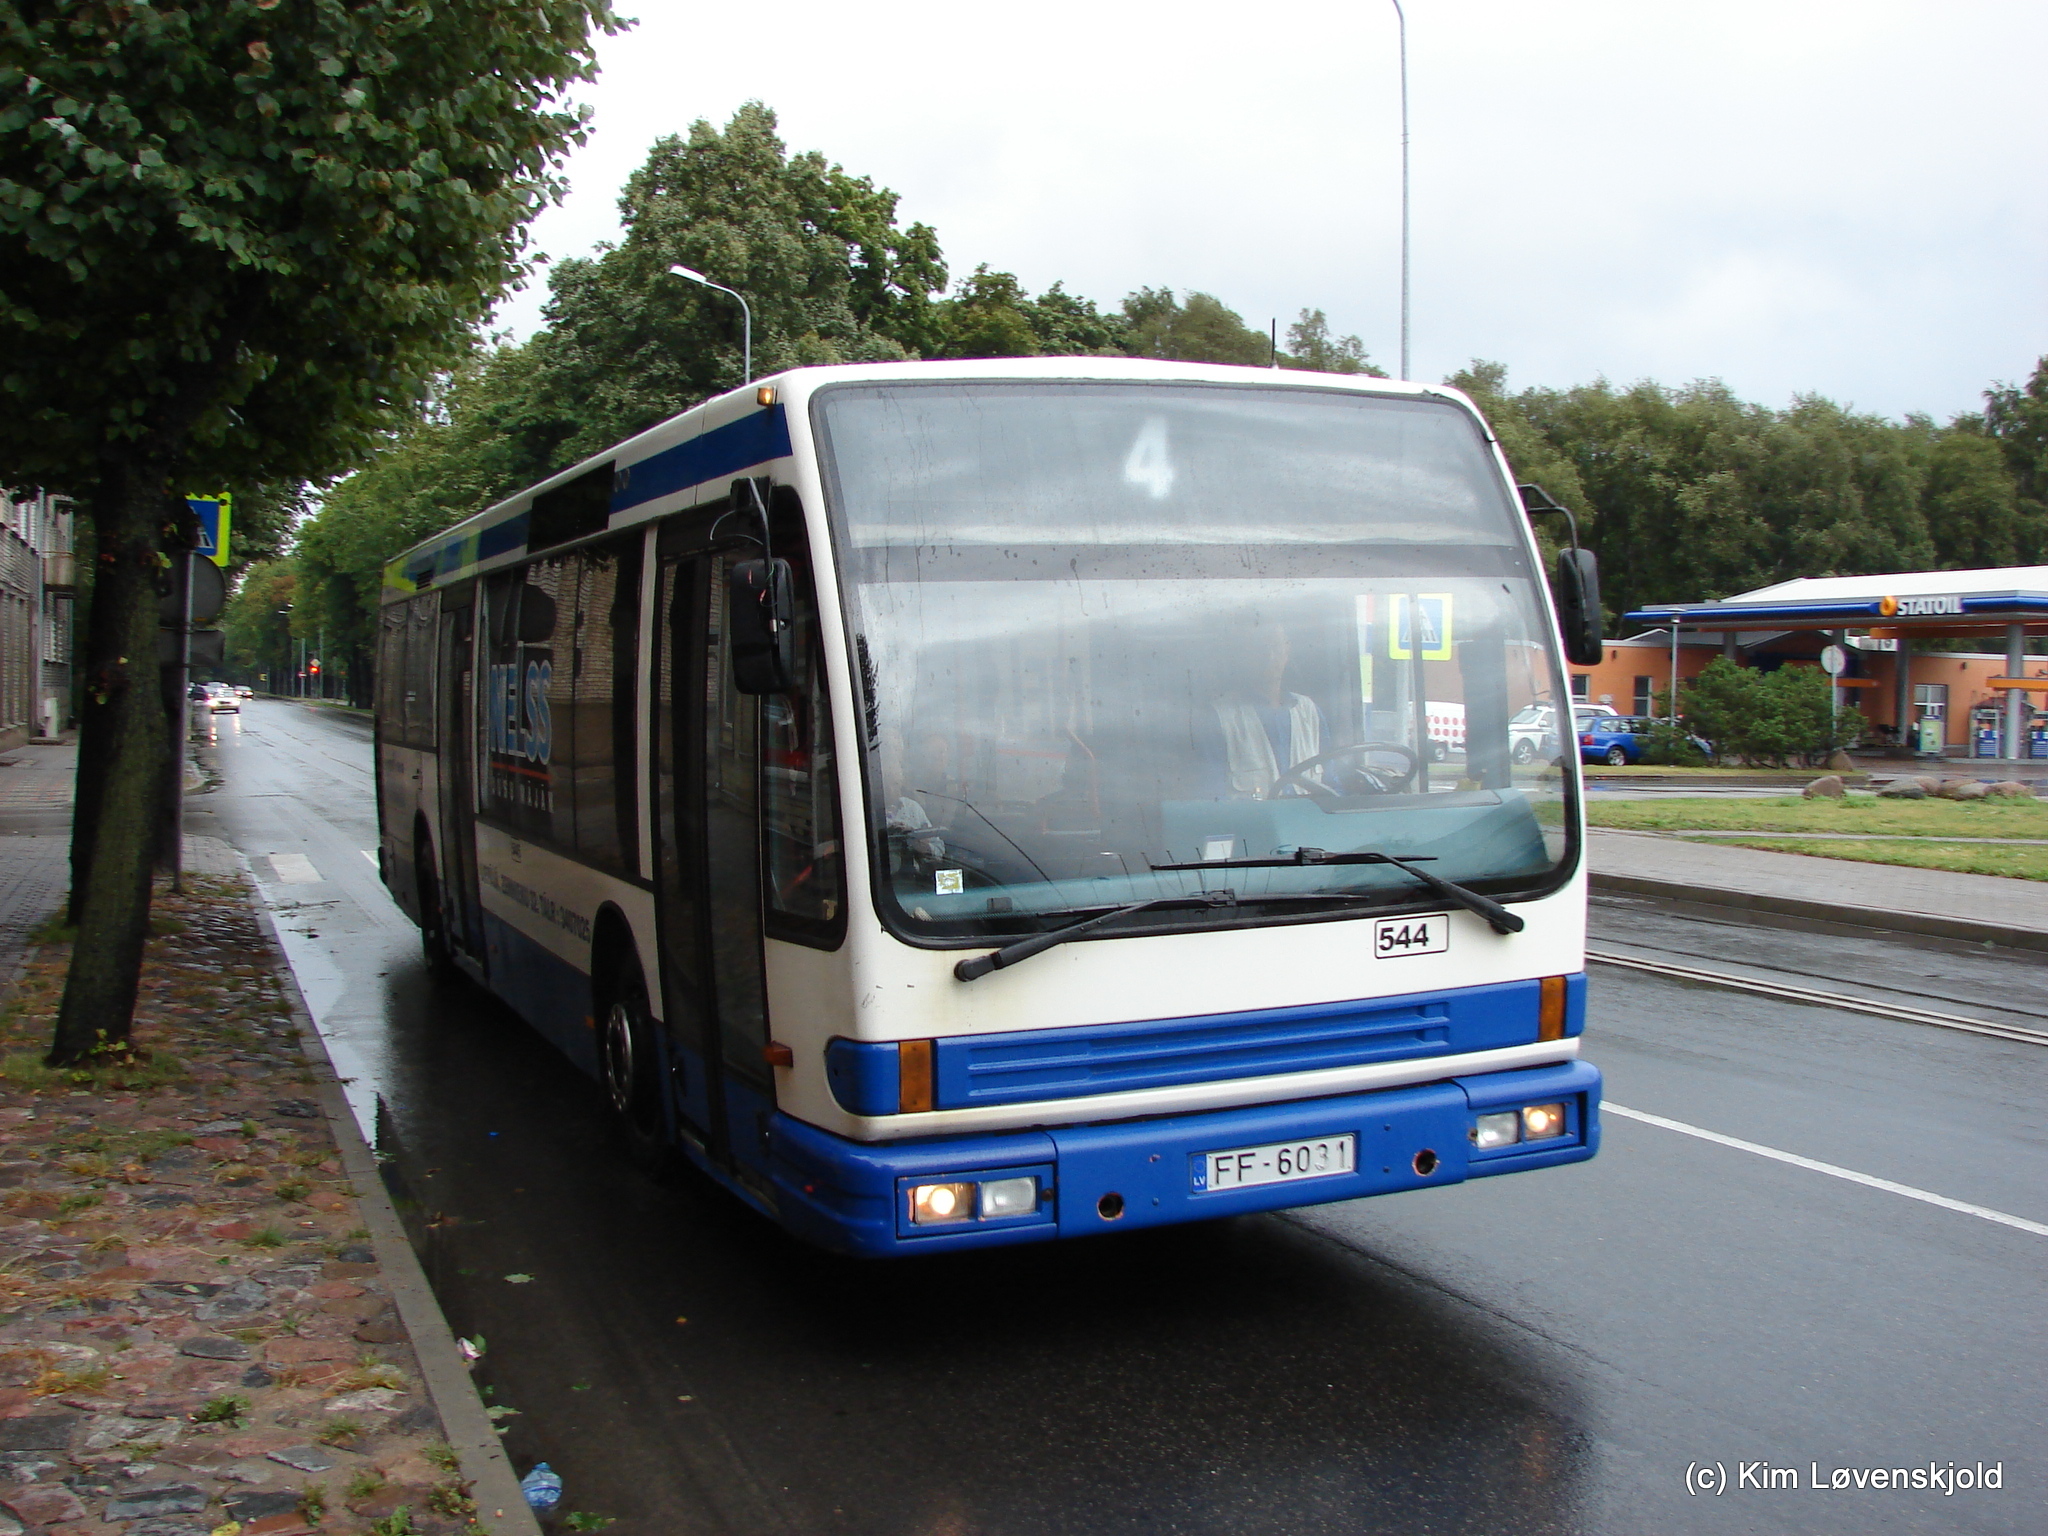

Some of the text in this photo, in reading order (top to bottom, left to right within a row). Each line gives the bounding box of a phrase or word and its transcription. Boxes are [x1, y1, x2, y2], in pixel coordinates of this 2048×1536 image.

[1124, 416, 1173, 500] 4
[1896, 596, 1963, 616] STATOIL
[490, 641, 552, 765] NELSS
[1379, 923, 1429, 951] 544
[1193, 1175, 1206, 1186] LV
